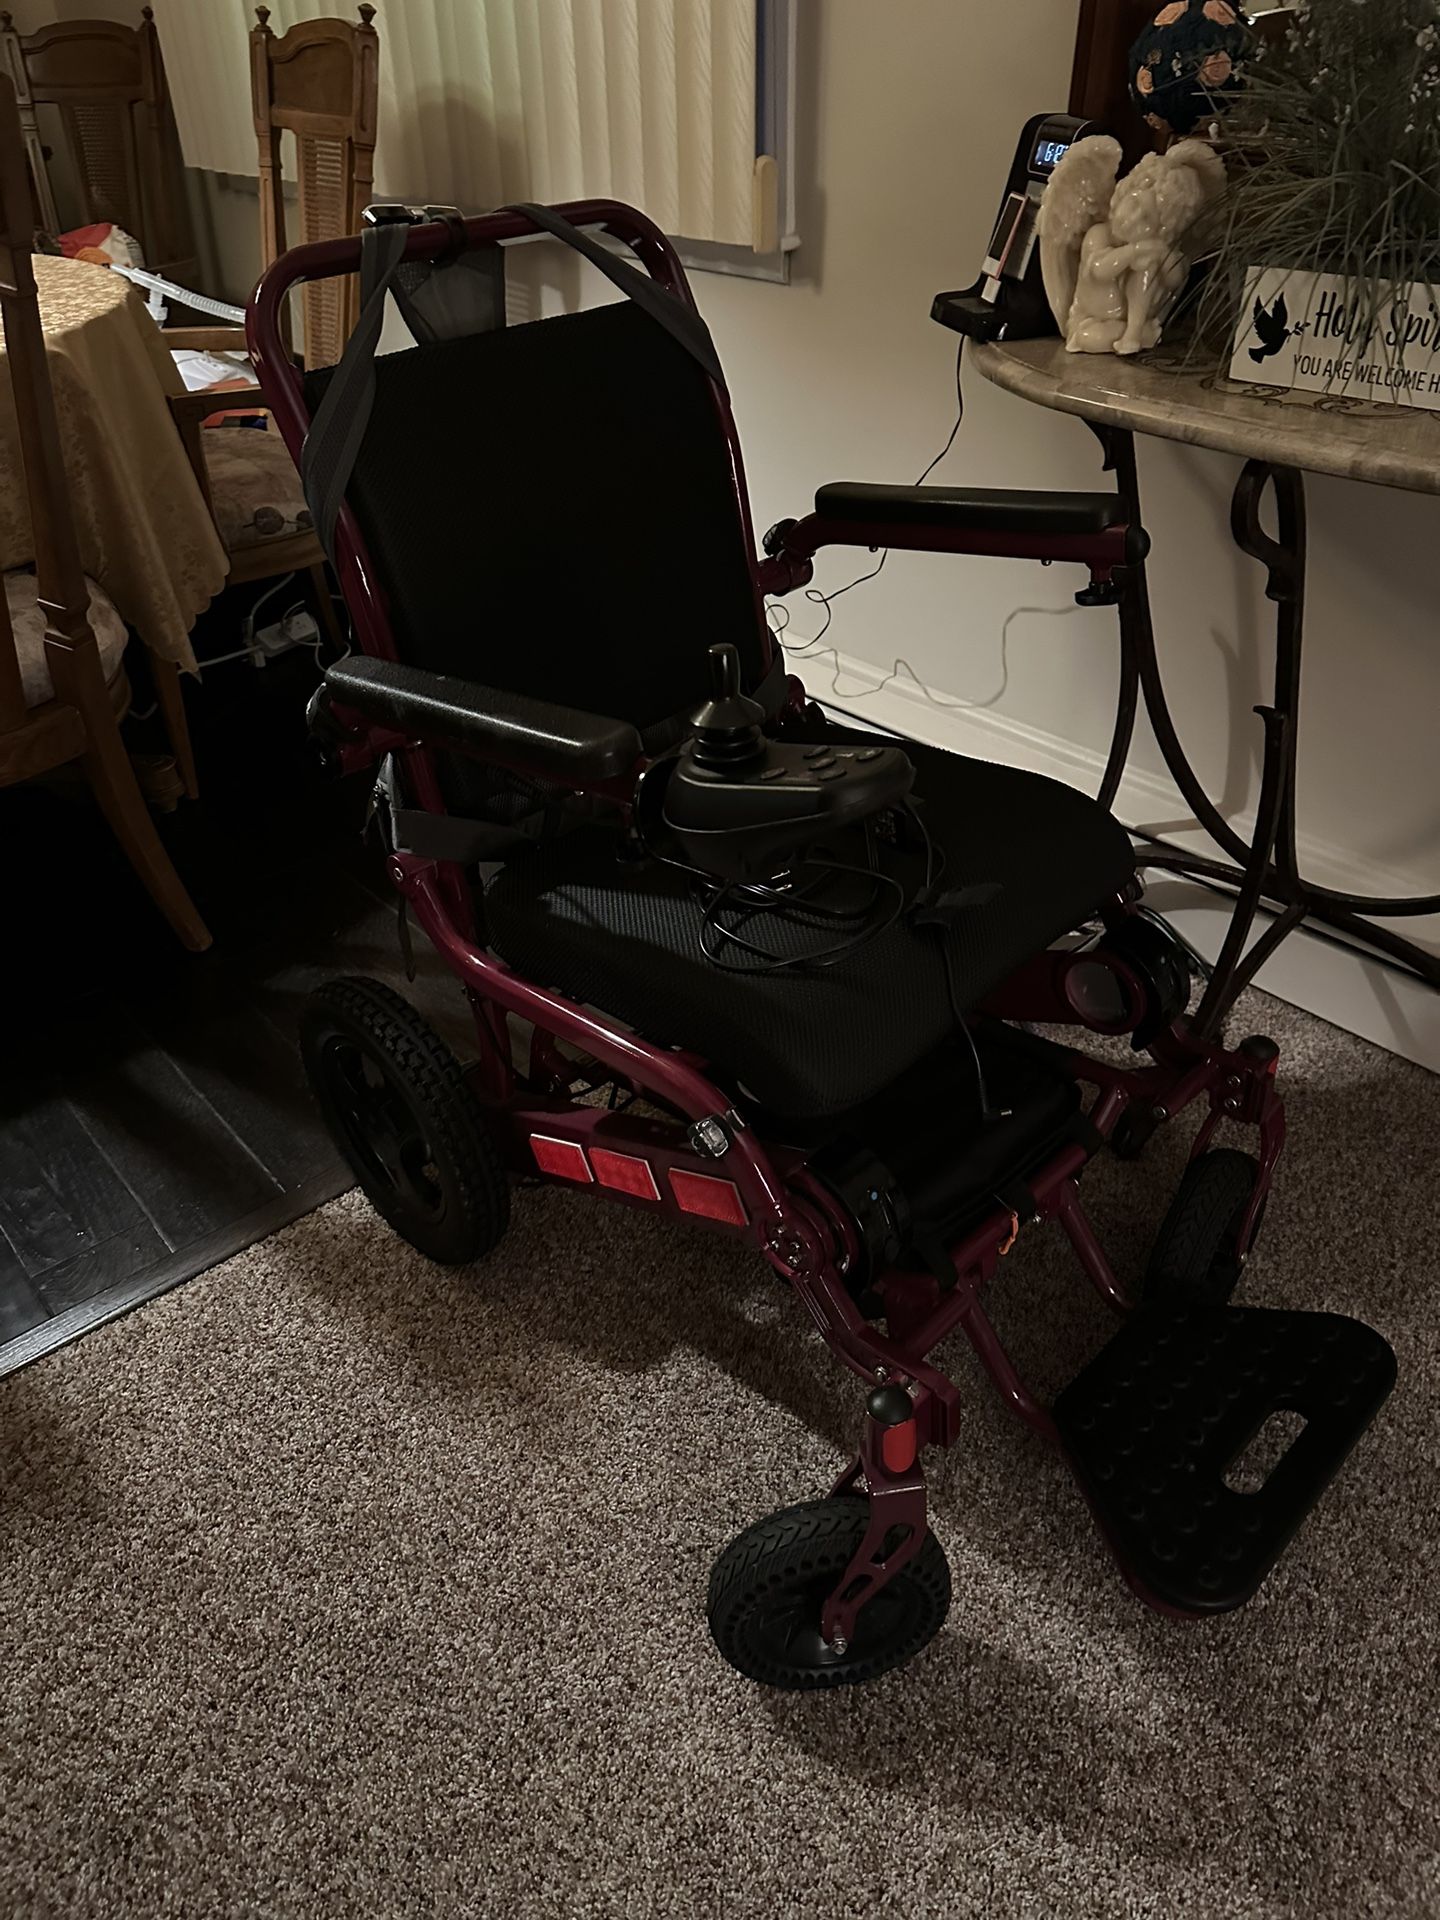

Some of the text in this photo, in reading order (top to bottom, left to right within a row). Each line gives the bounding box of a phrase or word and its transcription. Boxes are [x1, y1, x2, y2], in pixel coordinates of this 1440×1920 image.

[1313, 291, 1380, 360] Holy
[1294, 354, 1321, 376] YOU
[1322, 359, 1353, 381] ARE
[1354, 364, 1428, 392] WELCOME
